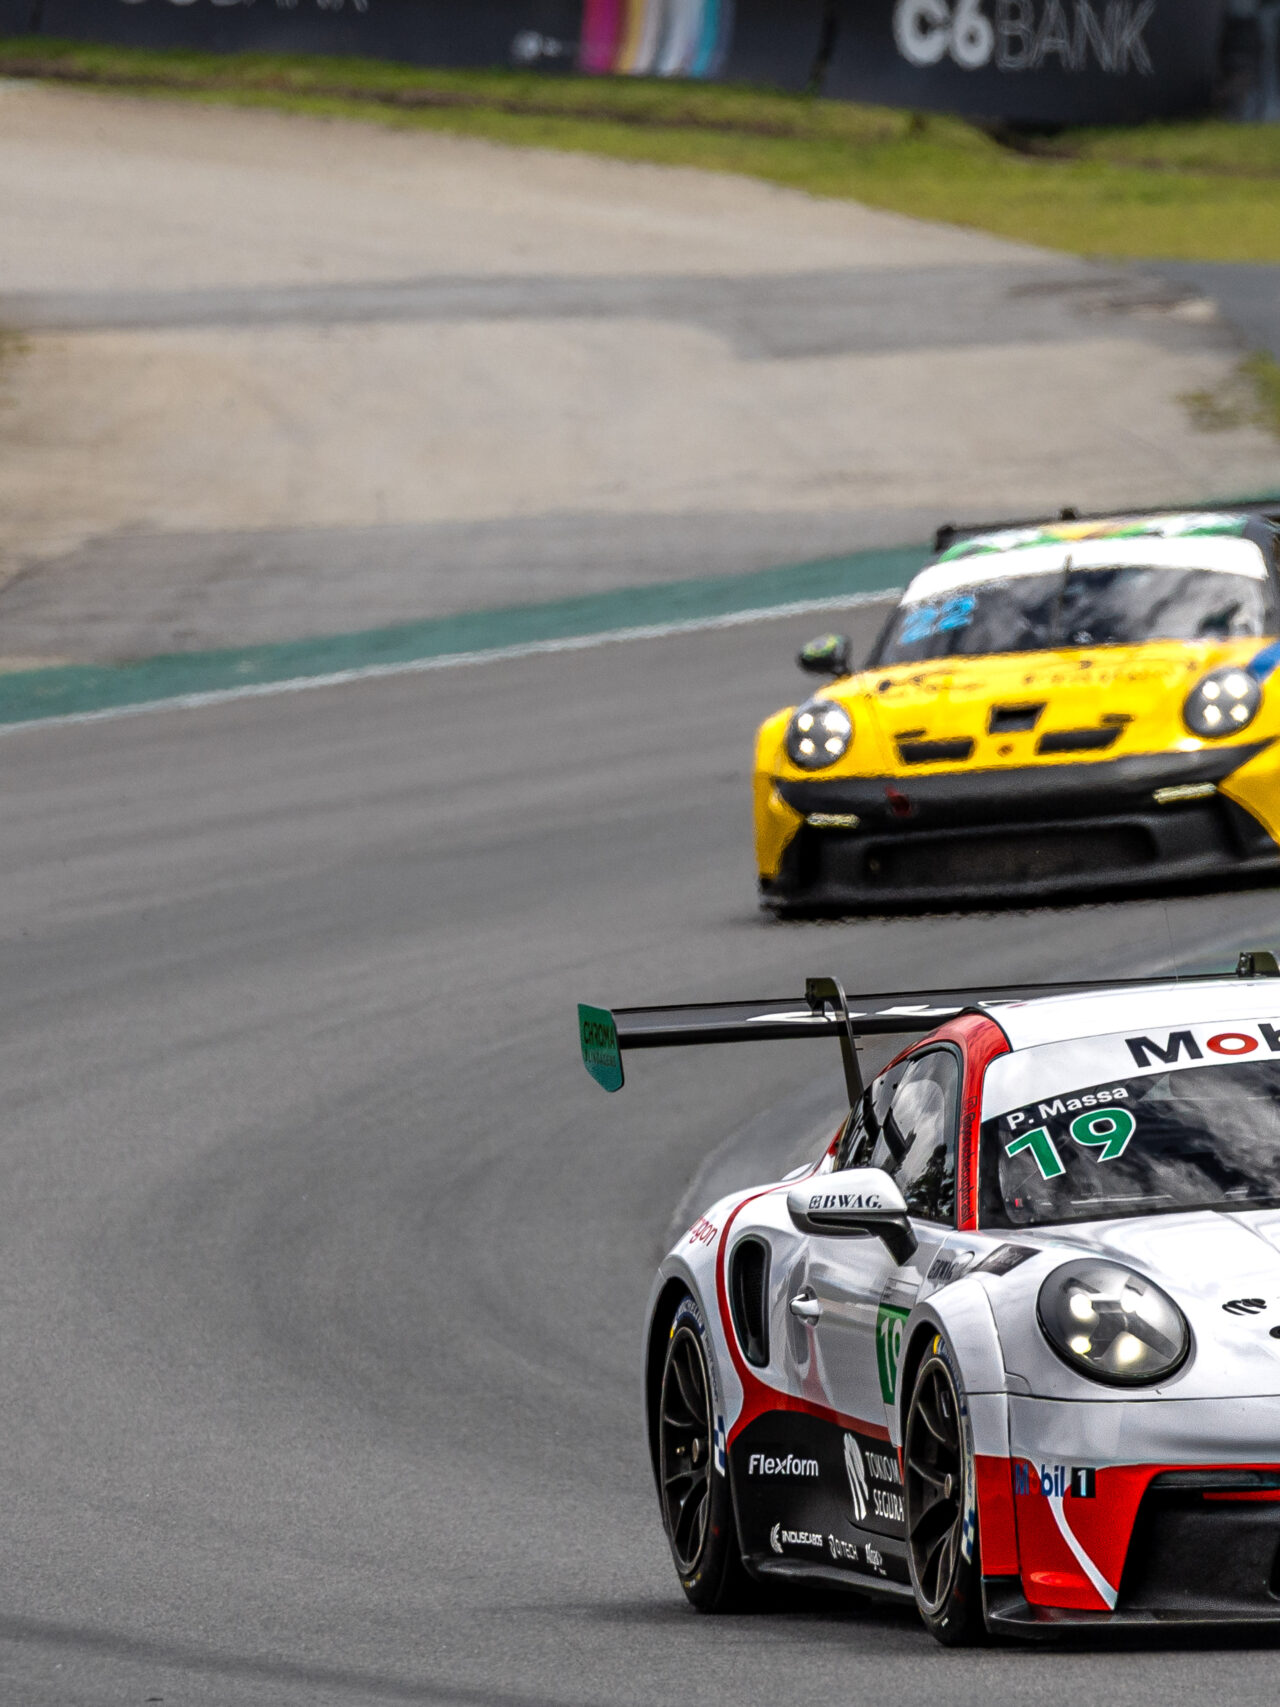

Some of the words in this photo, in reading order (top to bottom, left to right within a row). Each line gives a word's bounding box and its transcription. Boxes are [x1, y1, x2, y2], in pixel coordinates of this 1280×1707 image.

[894, 0, 995, 69] C6
[996, 0, 1154, 75] BANK
[1006, 1112, 1035, 1130] P.
[1038, 1087, 1129, 1119] Massa
[1004, 1107, 1137, 1181] 19
[749, 1454, 819, 1477] Flexform
[1015, 1464, 1065, 1497] Mobil
